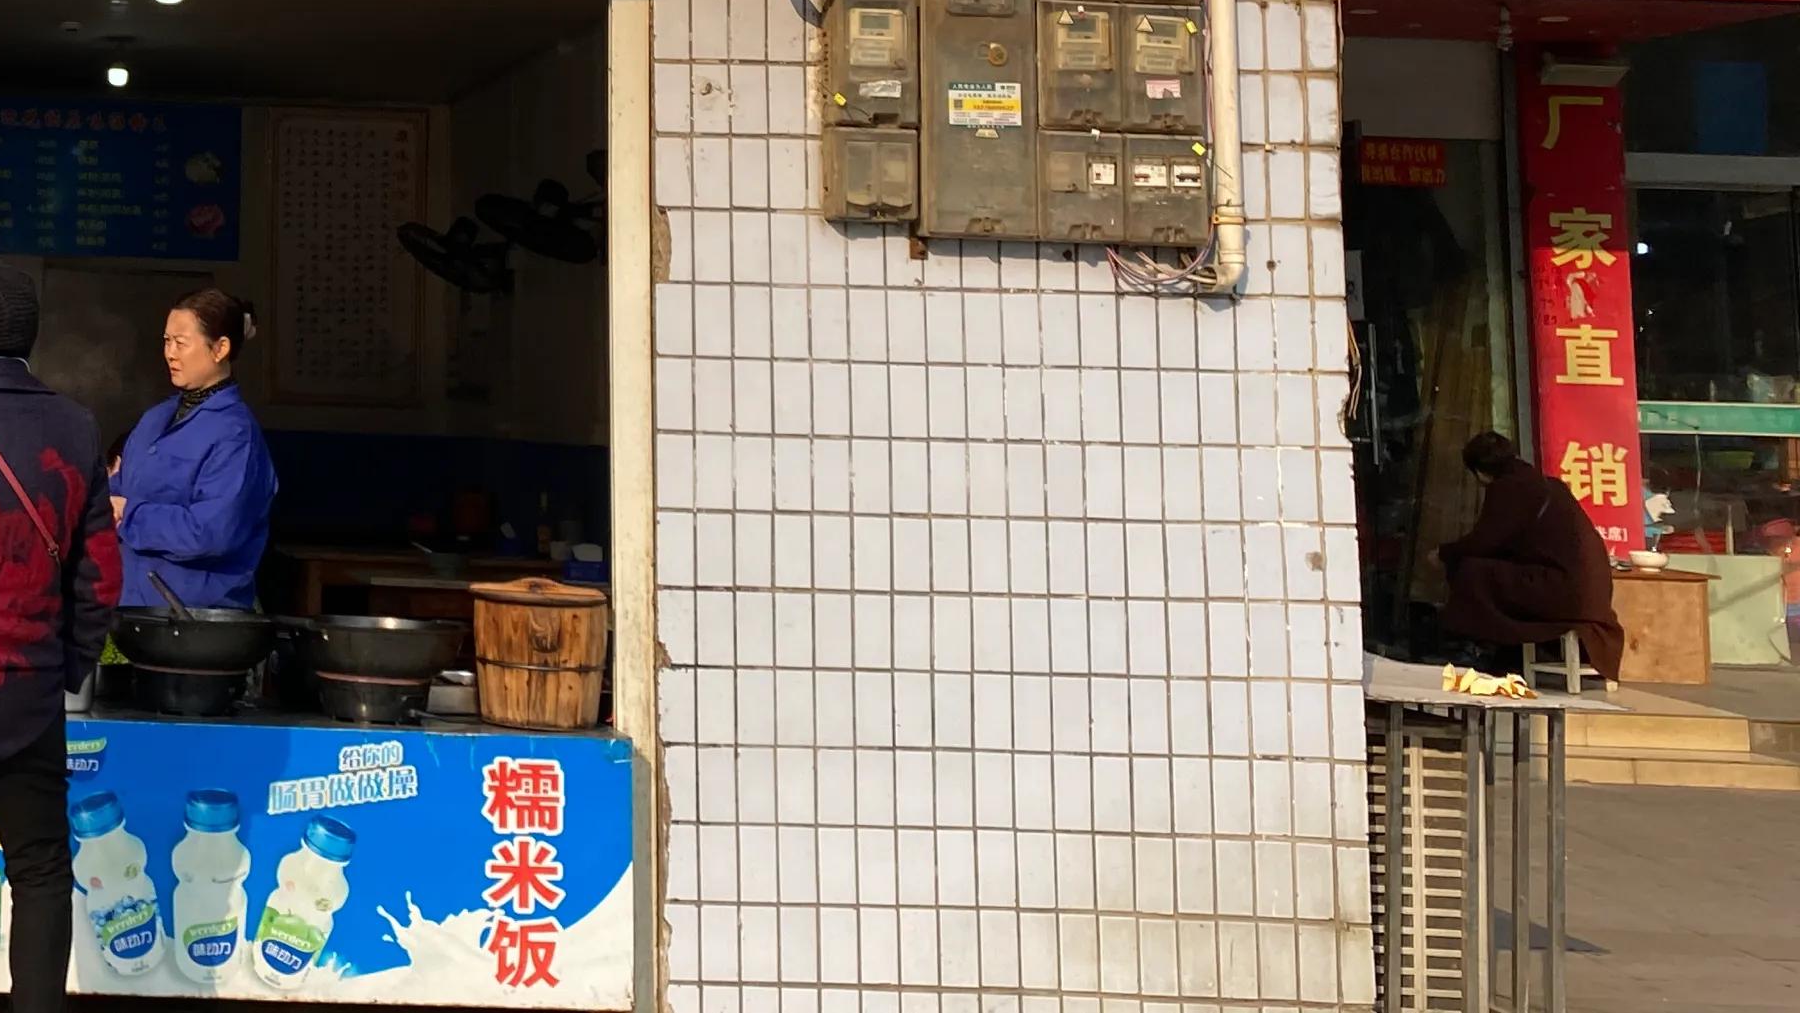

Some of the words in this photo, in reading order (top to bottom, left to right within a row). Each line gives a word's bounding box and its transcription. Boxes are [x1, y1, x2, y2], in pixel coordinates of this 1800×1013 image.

[1541, 94, 1629, 508] 厂家直销
[341, 741, 403, 771] 给你的
[268, 765, 418, 815] 肠胃做做操
[483, 757, 565, 989] 糯米饭
[114, 931, 153, 952] 味动力
[192, 942, 231, 957] 味动力
[264, 943, 303, 970] 味动力
